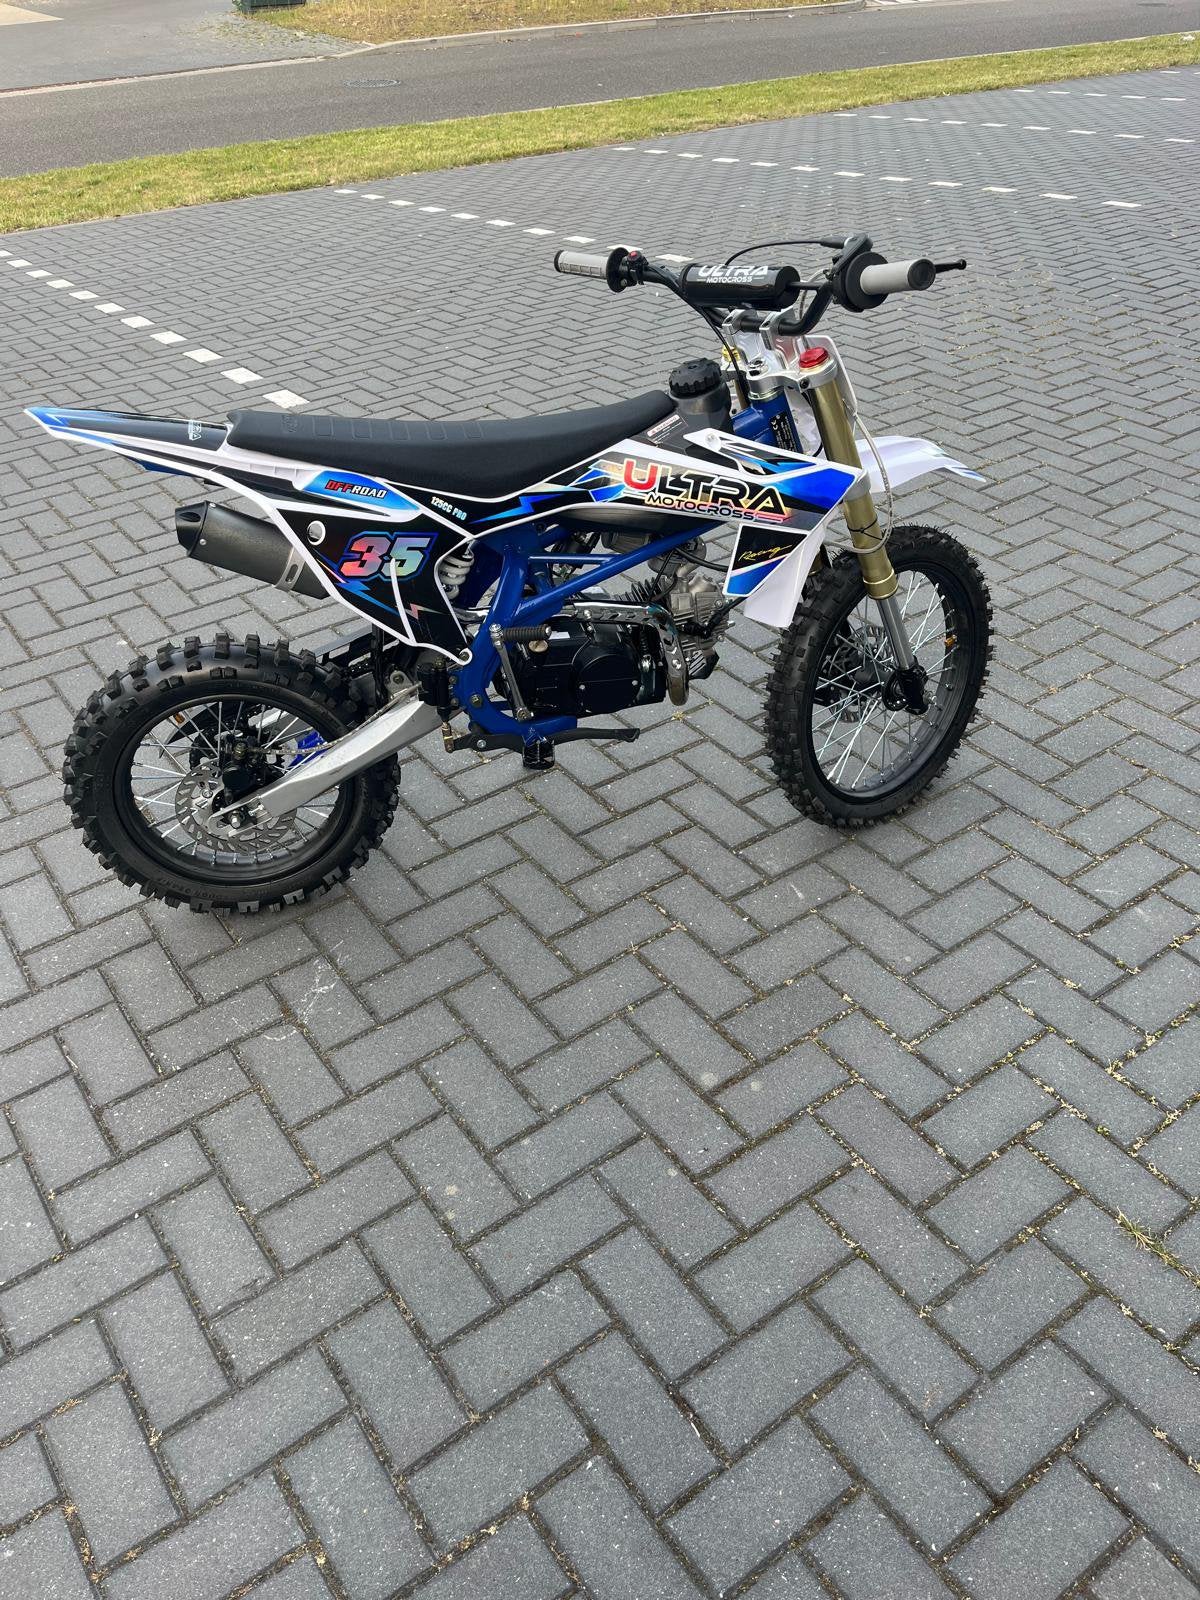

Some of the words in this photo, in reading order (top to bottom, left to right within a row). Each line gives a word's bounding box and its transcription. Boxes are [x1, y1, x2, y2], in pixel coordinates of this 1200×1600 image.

[697, 264, 769, 277] ULTRA
[706, 275, 753, 284] MOTOCROSS
[623, 459, 788, 516] ULTRA
[430, 496, 453, 513] 125CC
[452, 507, 468, 521] PRO
[646, 494, 755, 521] MOTOCROSS
[339, 535, 433, 578] 35
[738, 544, 793, 561] Racing
